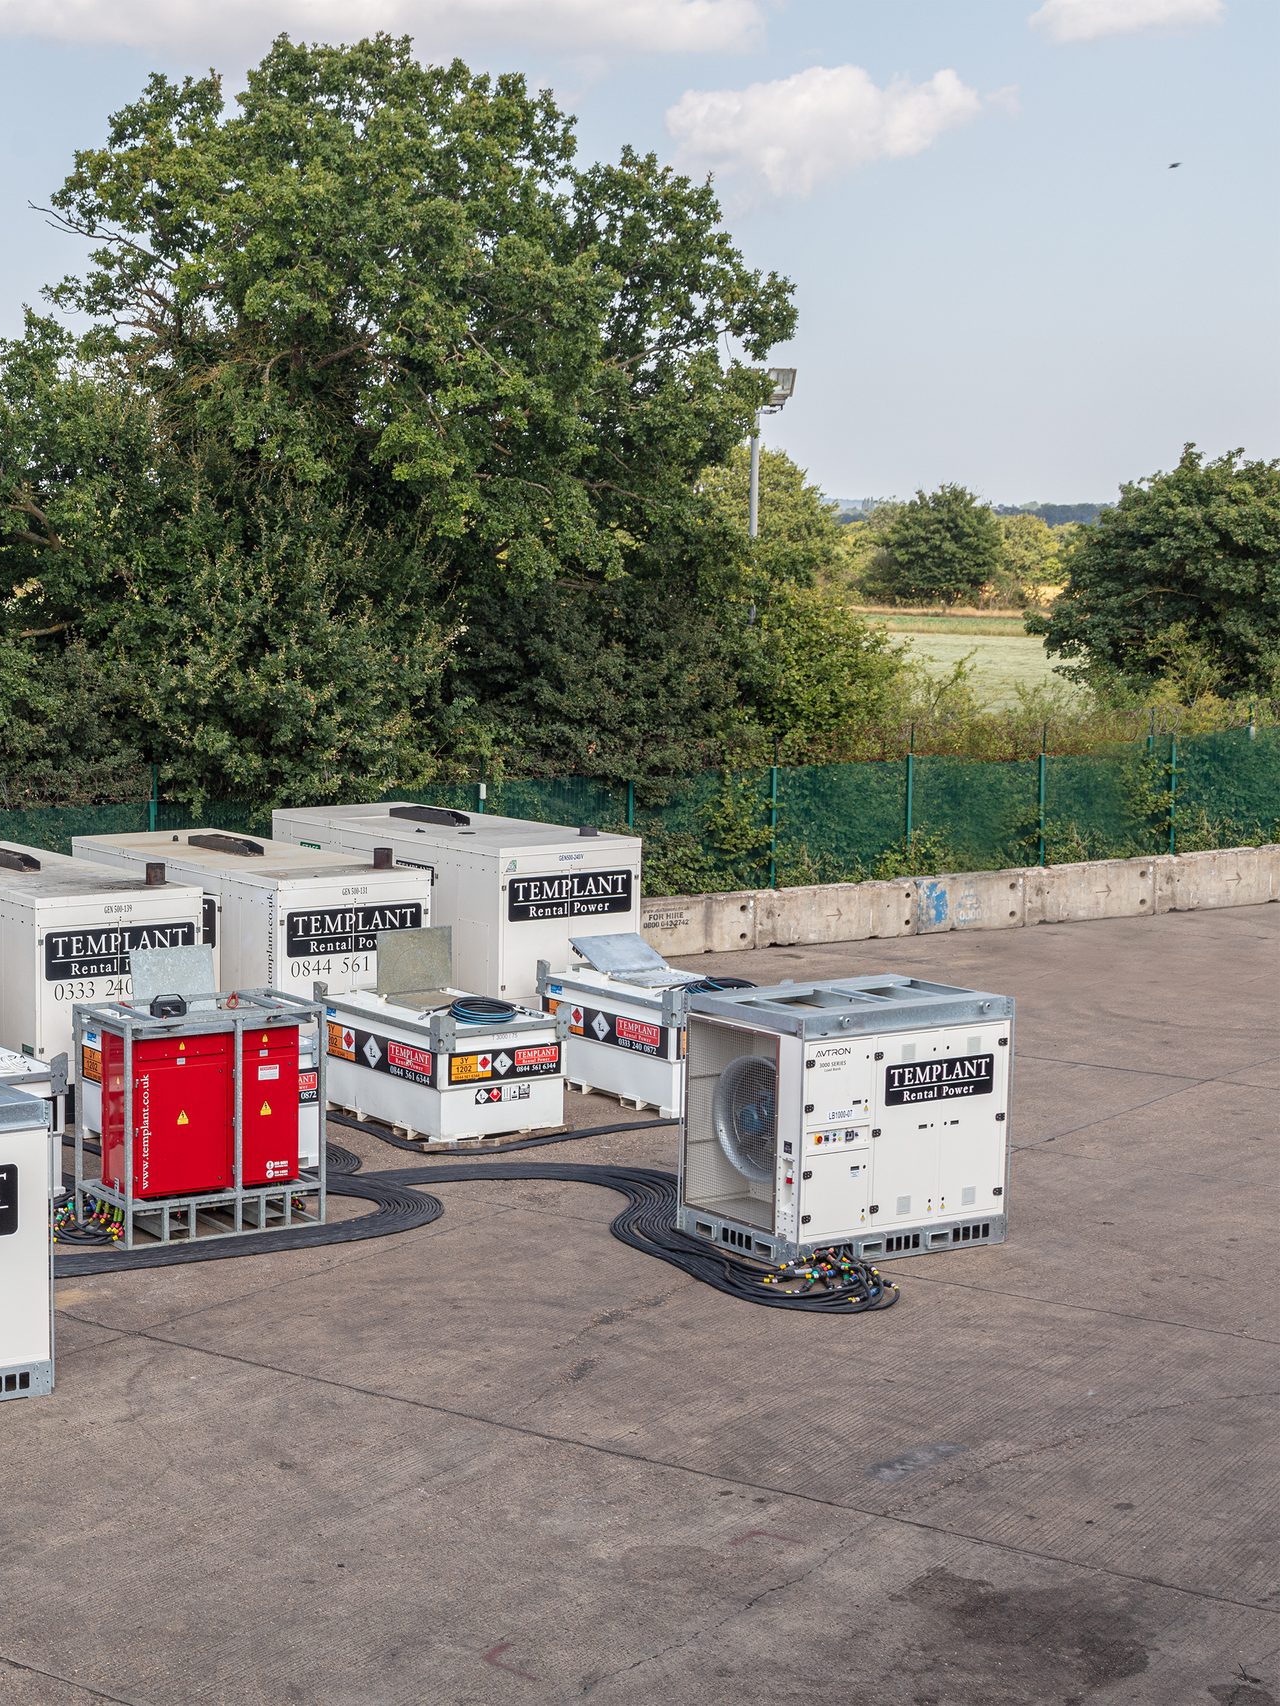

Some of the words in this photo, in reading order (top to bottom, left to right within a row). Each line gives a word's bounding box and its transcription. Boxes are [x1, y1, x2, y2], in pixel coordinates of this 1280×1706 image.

[341, 888, 351, 896] GEN
[514, 874, 627, 901] TEMPLANT
[103, 905, 114, 914] GEN
[529, 903, 568, 918] Rental
[573, 902, 609, 913] Power
[648, 913, 664, 921] FOR
[665, 911, 684, 919] HIRE
[293, 907, 416, 936] TEMPLANT
[52, 927, 188, 958] TEMPLANT
[266, 893, 275, 988] .templant.co.uk
[310, 937, 352, 953] Rental
[70, 959, 118, 976] Rental
[290, 958, 332, 978] 0844
[340, 955, 370, 974] 561
[54, 981, 95, 1001] 0333
[619, 1018, 658, 1037] TEMPLANT
[390, 1044, 430, 1066] TEMPLANT
[517, 1048, 556, 1059] TEMPLANT
[618, 1038, 631, 1047] 0333
[631, 1041, 642, 1051] 240
[643, 1045, 657, 1055] 0872
[815, 1047, 852, 1058] AVTRON
[456, 1065, 472, 1073] 1202
[459, 1057, 469, 1065] 3Y
[516, 1065, 530, 1073] 0844
[542, 1062, 556, 1070] 6344
[389, 1065, 404, 1077] 0844
[404, 1069, 415, 1081] 561
[416, 1073, 430, 1086] 6344
[890, 1058, 990, 1087] TEMPLANT
[300, 1090, 317, 1100] 0872
[903, 1087, 937, 1102] Rental
[942, 1085, 974, 1096] Power
[828, 1109, 853, 1120] LB1000-07
[140, 1073, 152, 1190] www.templant.co.uk
